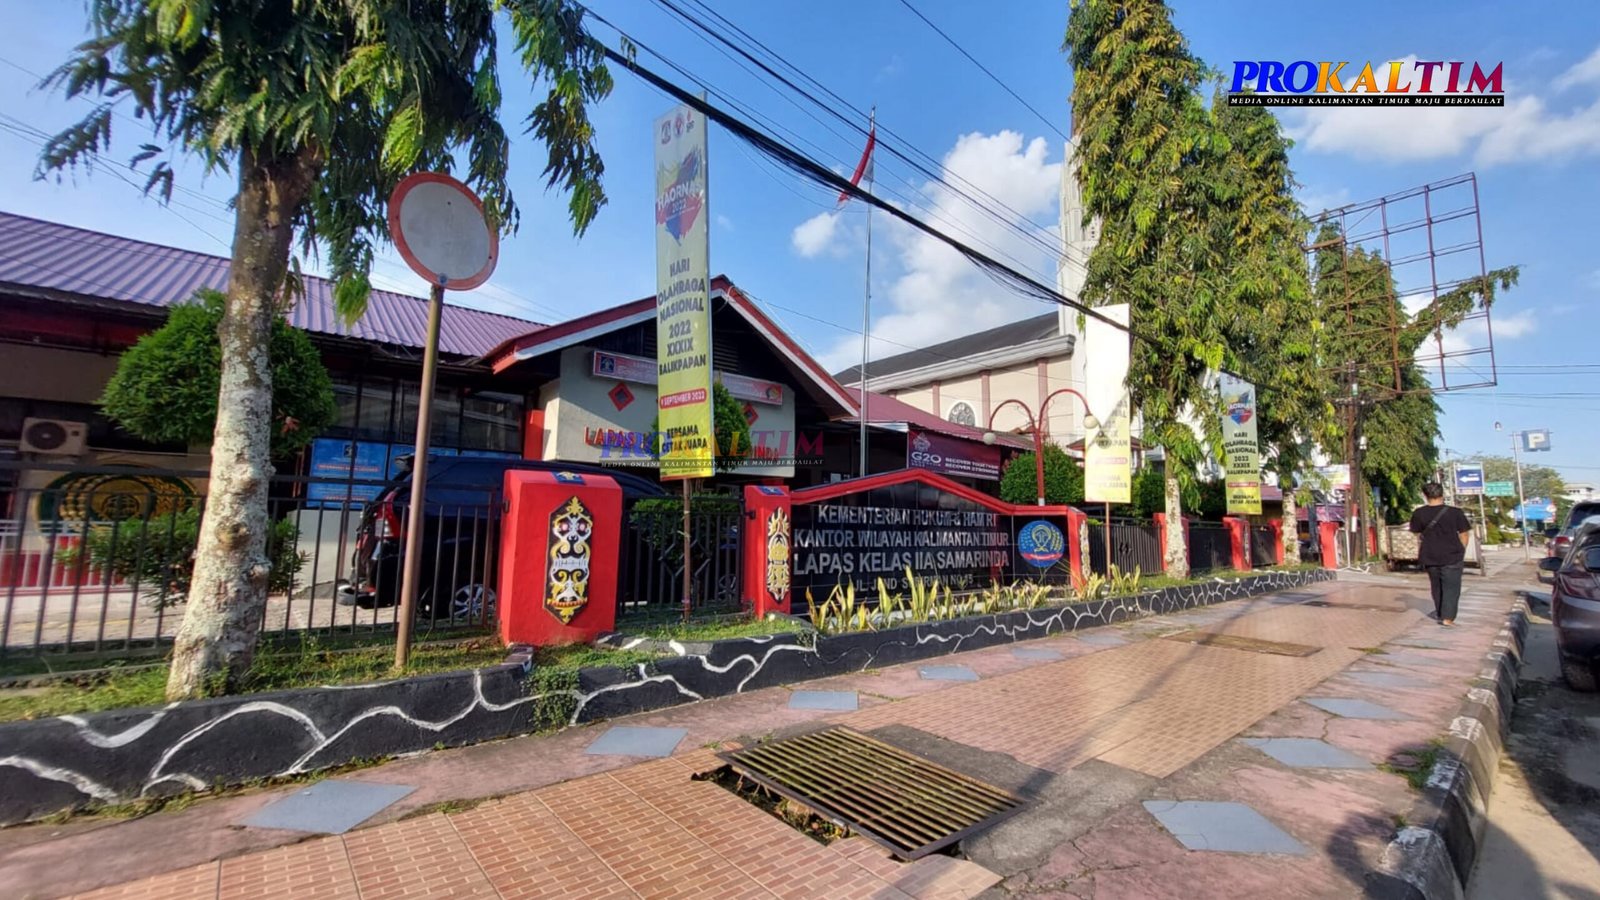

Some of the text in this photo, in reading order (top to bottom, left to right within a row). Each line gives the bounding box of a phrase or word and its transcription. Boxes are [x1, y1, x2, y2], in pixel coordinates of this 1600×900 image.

[669, 257, 690, 277] HARI
[657, 278, 706, 306] OLAHRAGA
[660, 298, 704, 323] NASIONAL
[668, 320, 692, 339] 2022
[666, 337, 694, 357] XXXIX
[659, 354, 706, 376] BALIKPAPAN
[583, 424, 636, 448] LAPAS
[666, 424, 699, 439] BERSAMA
[1528, 432, 1545, 449] P
[1225, 440, 1257, 448] OLAHRAGA
[1226, 447, 1257, 455] NASIONAL
[911, 452, 941, 464] G20
[818, 504, 910, 525] KEMENTERIAN
[913, 509, 951, 526] HUKUM
[963, 511, 985, 527] HAM
[986, 512, 997, 527] RI
[793, 528, 1009, 548] KANTOR WILAYAH KALIMANTAN TIMUR
[793, 550, 1009, 575] LAPAS KELAS IIA SAMARINDA
